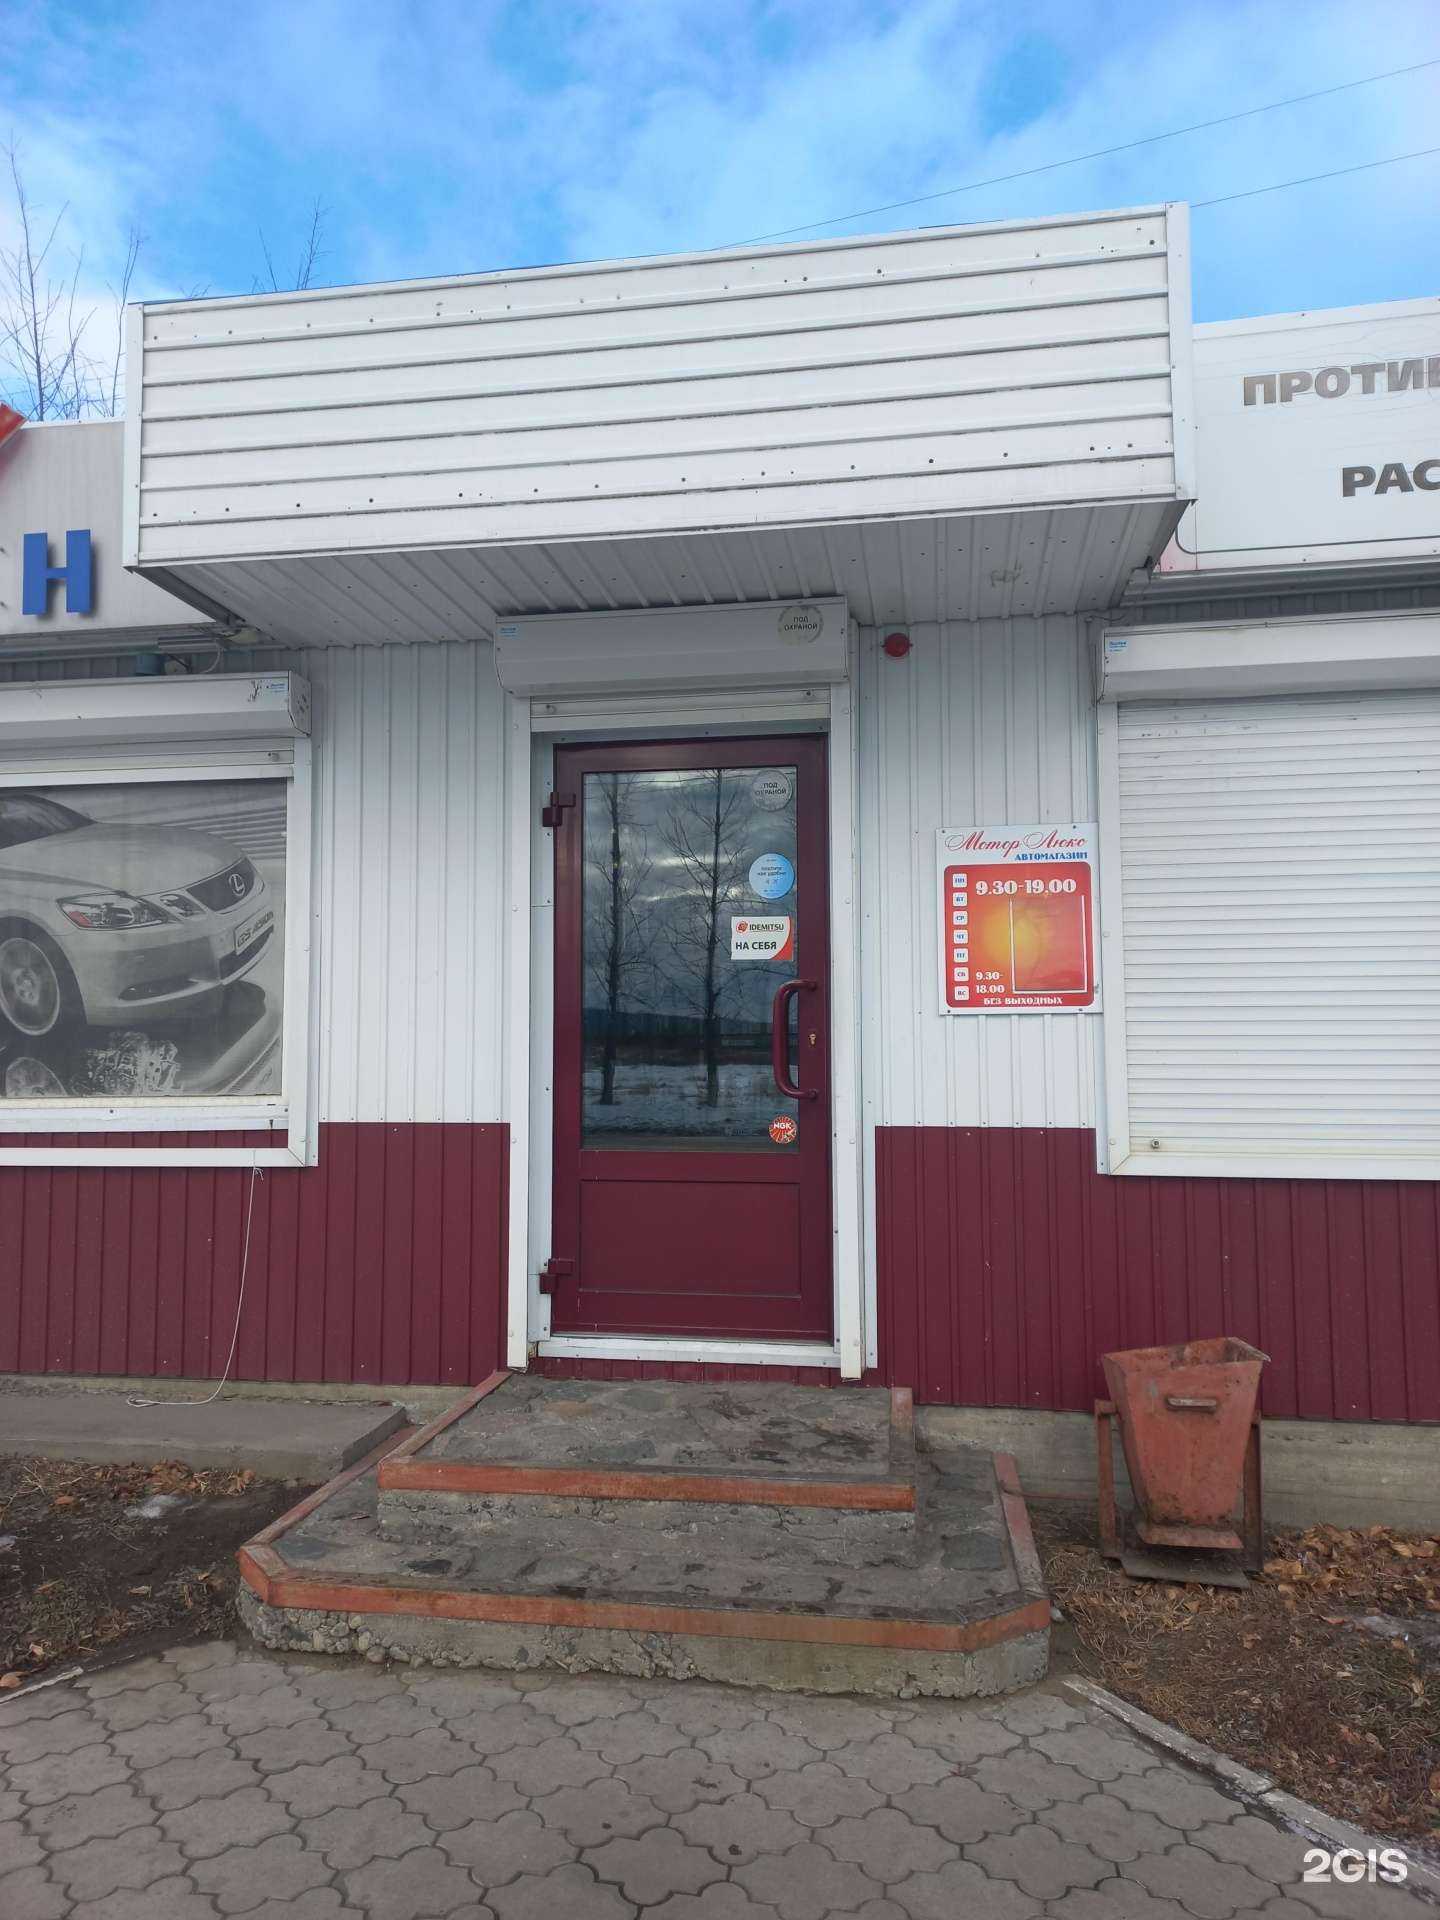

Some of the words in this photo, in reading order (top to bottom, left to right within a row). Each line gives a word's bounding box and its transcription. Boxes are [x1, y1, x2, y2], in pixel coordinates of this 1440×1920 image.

[945, 831, 1020, 857] Мотор
[1014, 852, 1088, 861] АВТОМАГАЗИН
[975, 879, 1077, 896] 9.30-19.00
[749, 923, 784, 931] IDEMITSU
[735, 941, 749, 950] НА
[751, 941, 777, 950] СЕБЯ
[975, 984, 1005, 994] 18.00
[983, 997, 1001, 1005] БЕЗ
[1004, 996, 1062, 1005] ВЫХОДНЫХ
